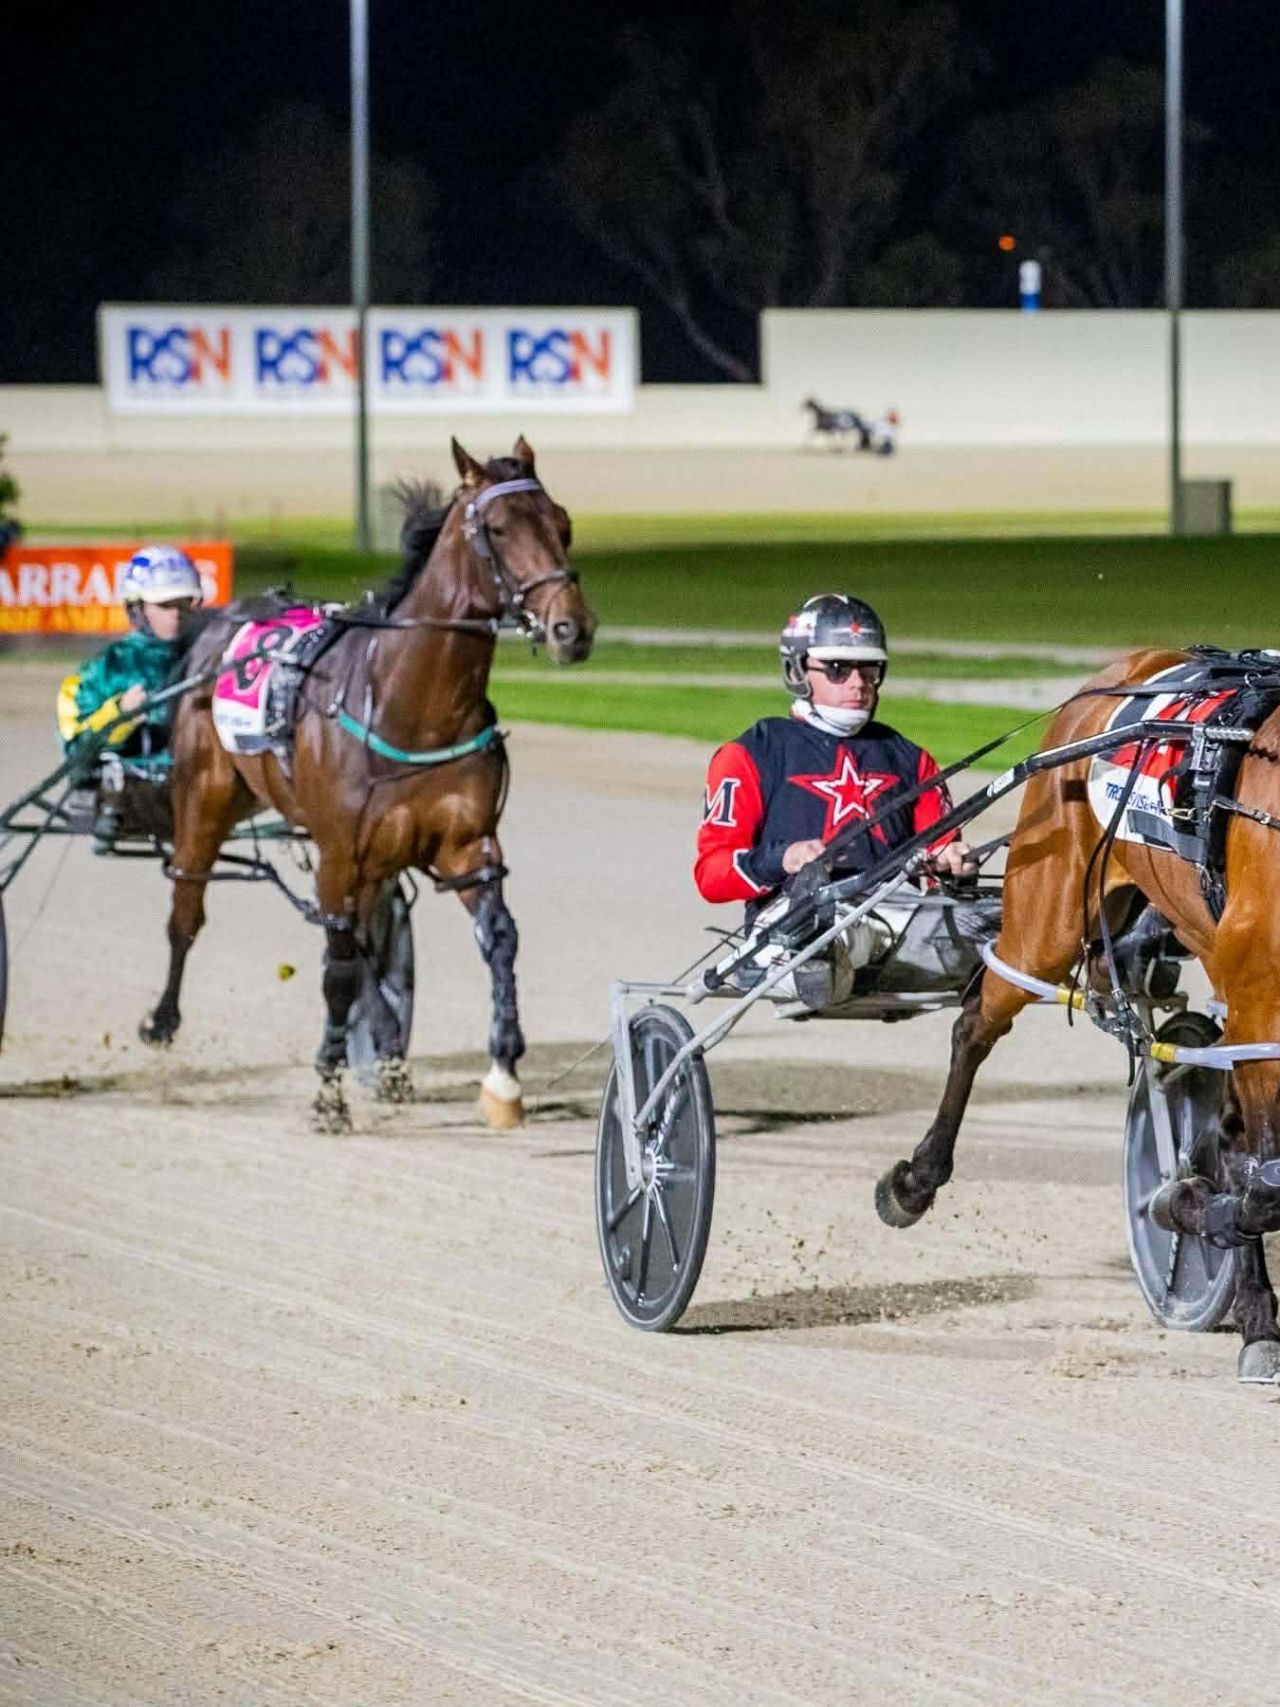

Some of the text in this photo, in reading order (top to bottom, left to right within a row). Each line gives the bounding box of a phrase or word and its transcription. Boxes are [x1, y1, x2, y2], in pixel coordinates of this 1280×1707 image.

[126, 327, 231, 383] RSN
[254, 327, 358, 384] RSN
[379, 328, 484, 383] RSN
[507, 328, 612, 384] RSN
[702, 776, 741, 828] M
